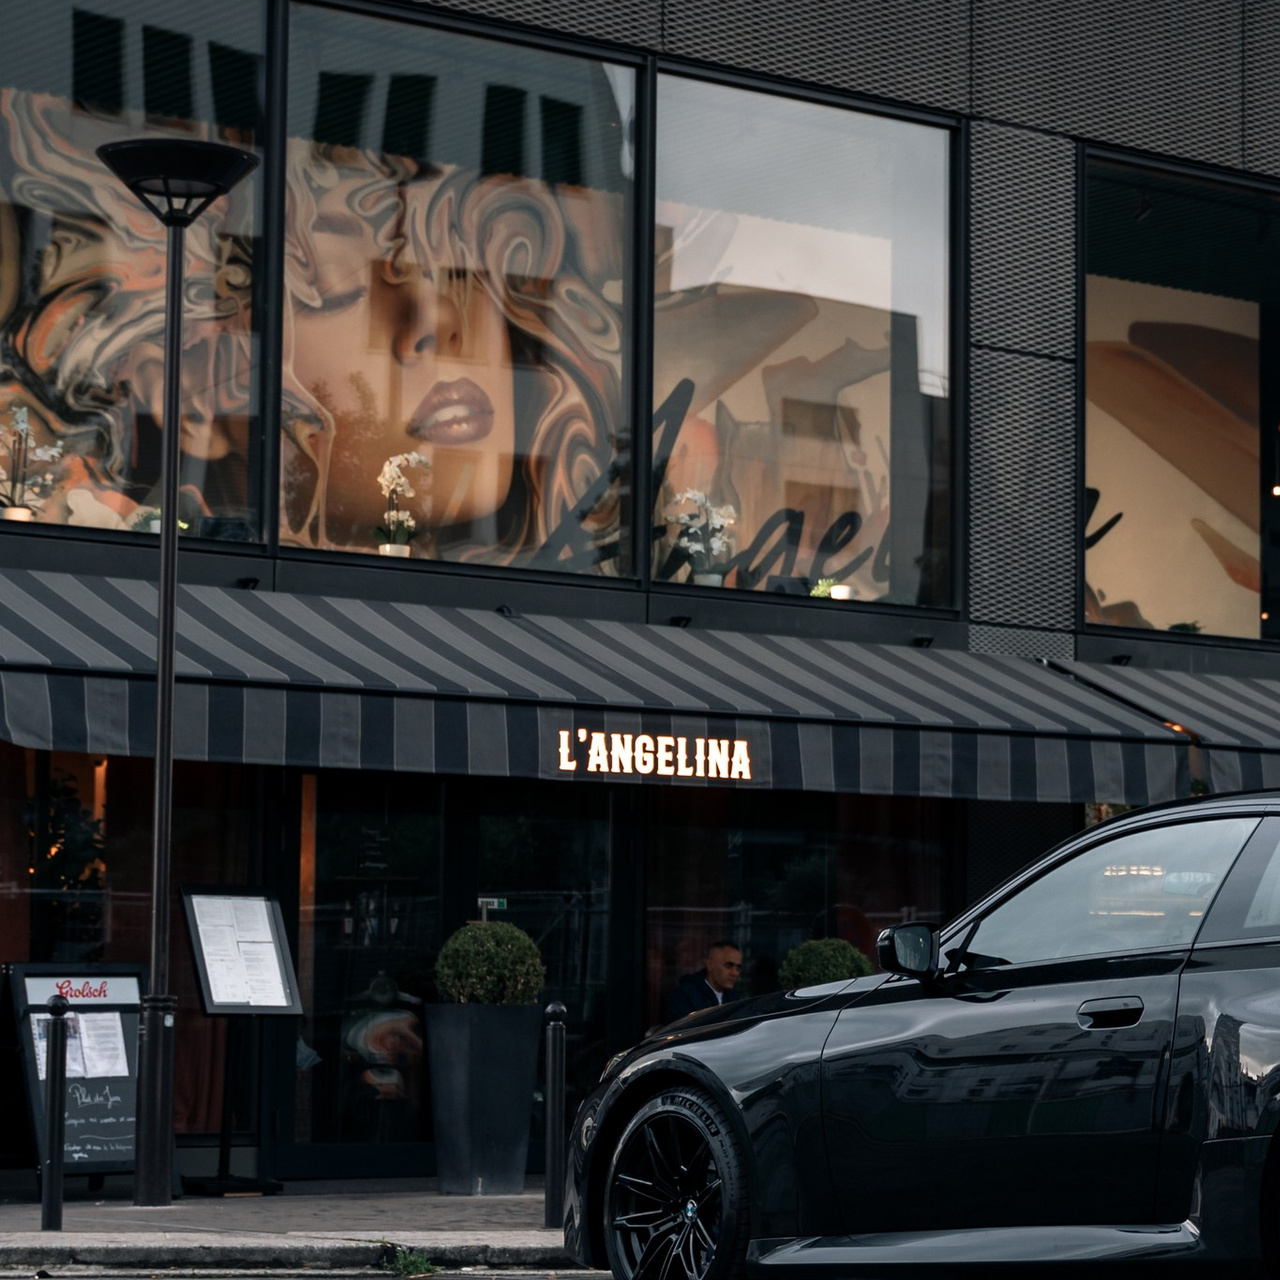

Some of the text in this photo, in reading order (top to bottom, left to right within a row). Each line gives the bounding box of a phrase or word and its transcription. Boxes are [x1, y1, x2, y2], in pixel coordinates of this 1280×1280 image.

[559, 728, 752, 780] L'ANGELINA
[56, 979, 108, 999] Grolsch
[672, 1096, 718, 1134] MICHELIN
